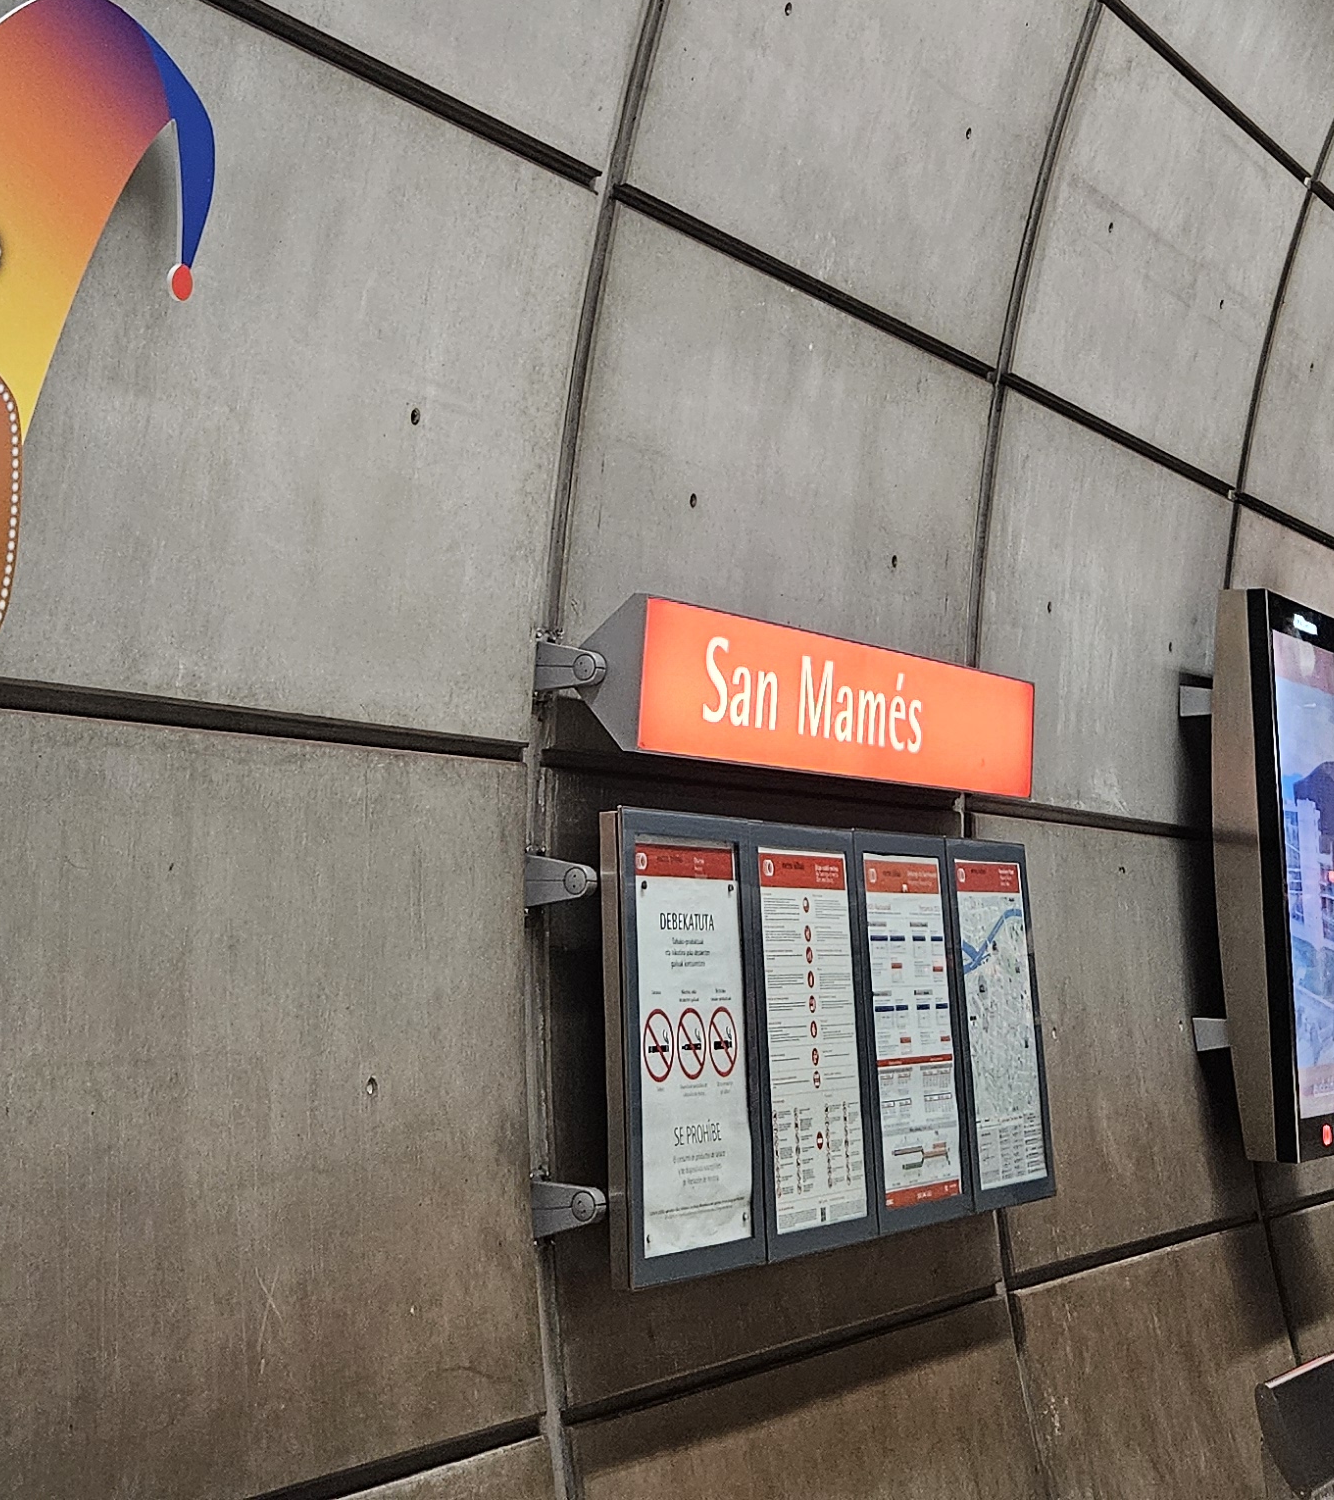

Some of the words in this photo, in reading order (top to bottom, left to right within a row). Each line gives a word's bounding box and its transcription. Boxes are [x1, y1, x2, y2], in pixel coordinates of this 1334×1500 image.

[701, 636, 779, 731] San
[798, 654, 924, 754] Mamés
[660, 912, 715, 931] DEBEKATUTA
[674, 1127, 685, 1146] SE
[686, 1118, 722, 1146] PROHÍBE
